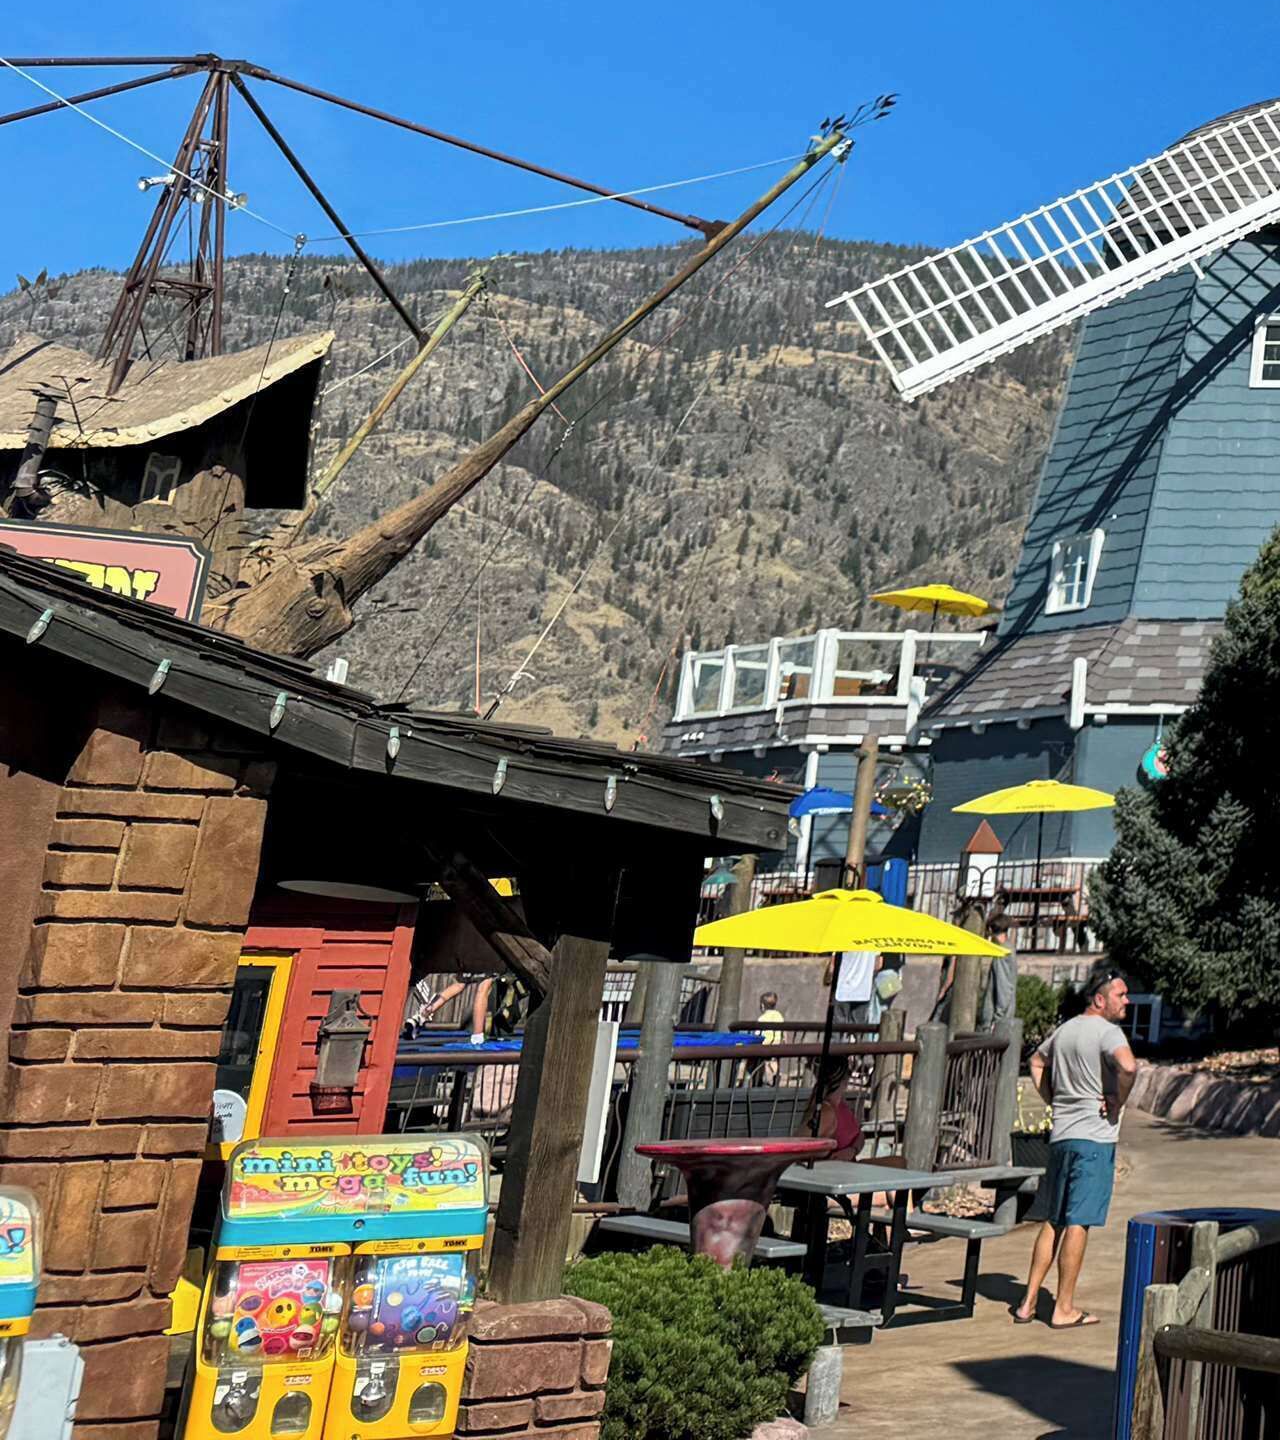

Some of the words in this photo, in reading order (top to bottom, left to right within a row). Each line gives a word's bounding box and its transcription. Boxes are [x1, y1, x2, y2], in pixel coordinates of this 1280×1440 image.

[241, 1150, 336, 1174] mini
[350, 1147, 443, 1172] toys!
[280, 1173, 387, 1195] mega
[402, 1162, 479, 1187] fun!
